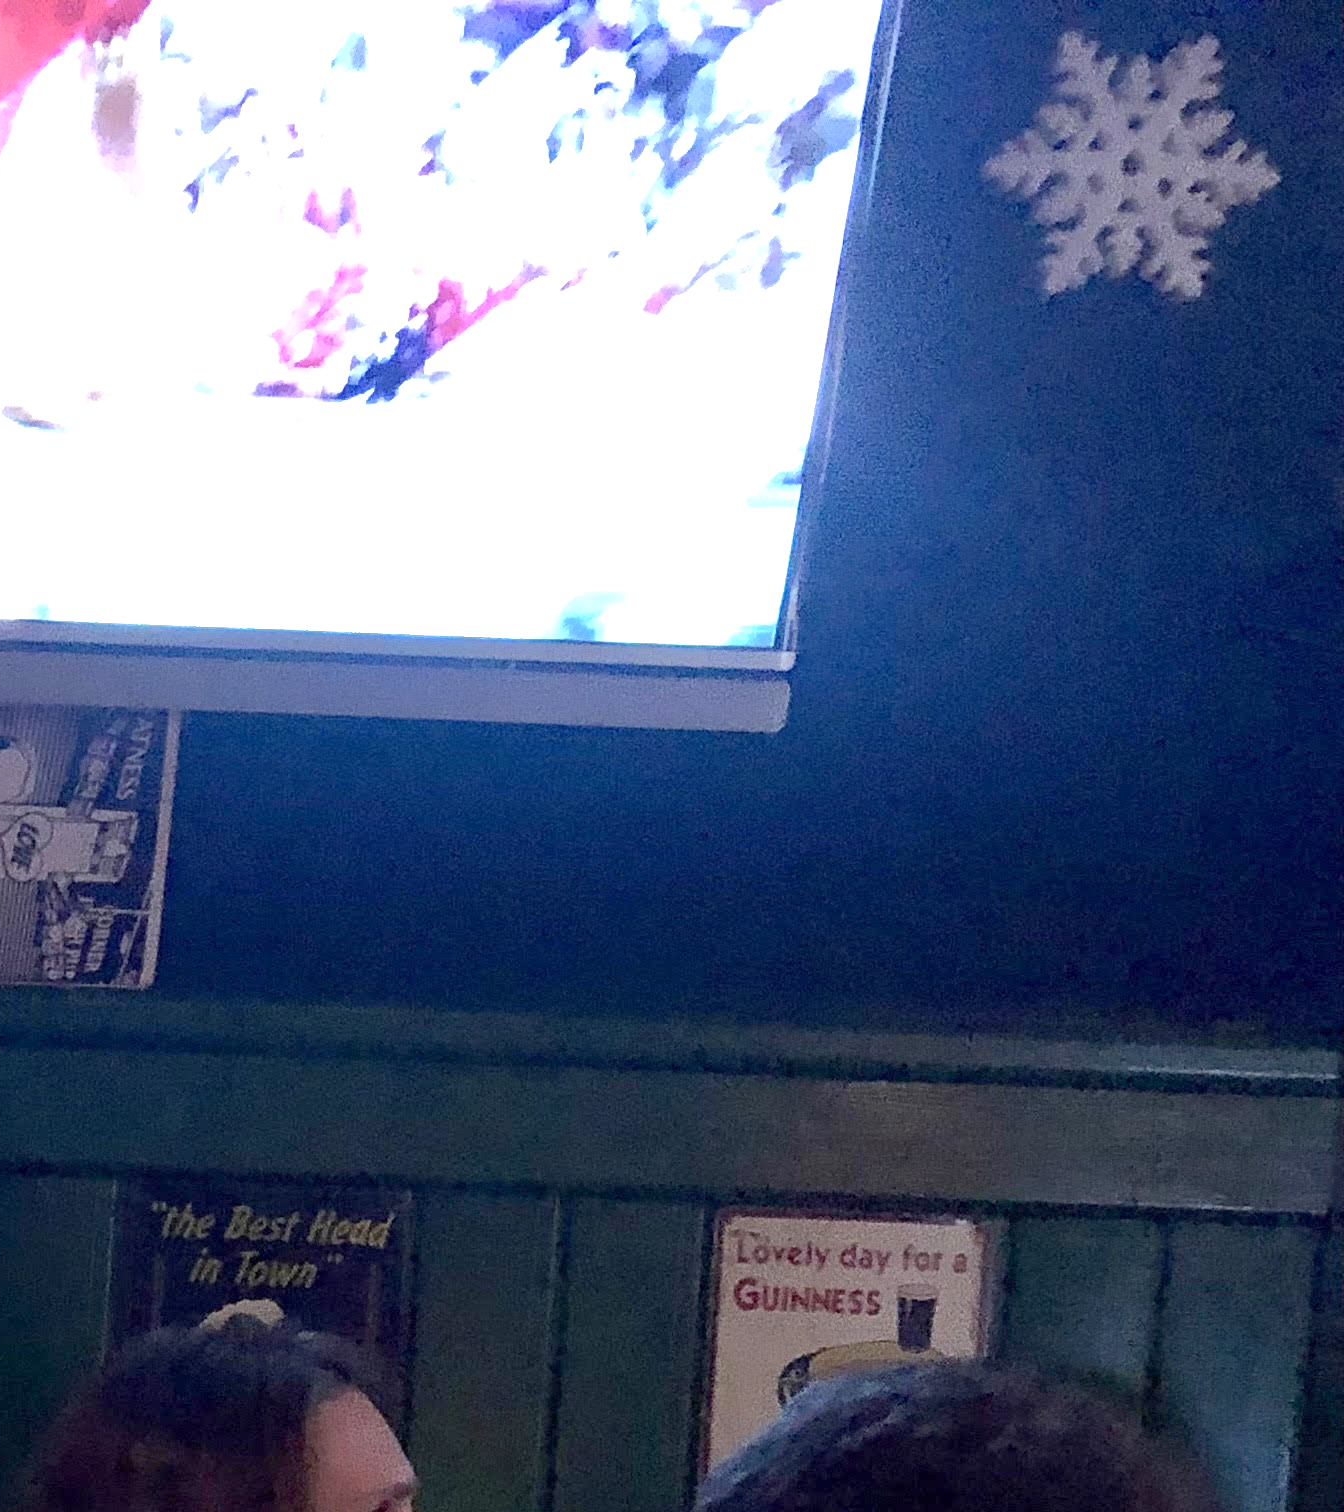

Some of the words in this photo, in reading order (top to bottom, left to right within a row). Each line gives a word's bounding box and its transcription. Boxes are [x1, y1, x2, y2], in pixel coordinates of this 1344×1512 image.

[223, 1204, 302, 1243] Best
[305, 1208, 397, 1250] Head
[187, 1246, 225, 1285] in
[734, 1233, 830, 1271] Lovely
[840, 1243, 892, 1275] day
[902, 1243, 944, 1273] for
[951, 1252, 969, 1275] a
[732, 1277, 882, 1317] GUINNESS
